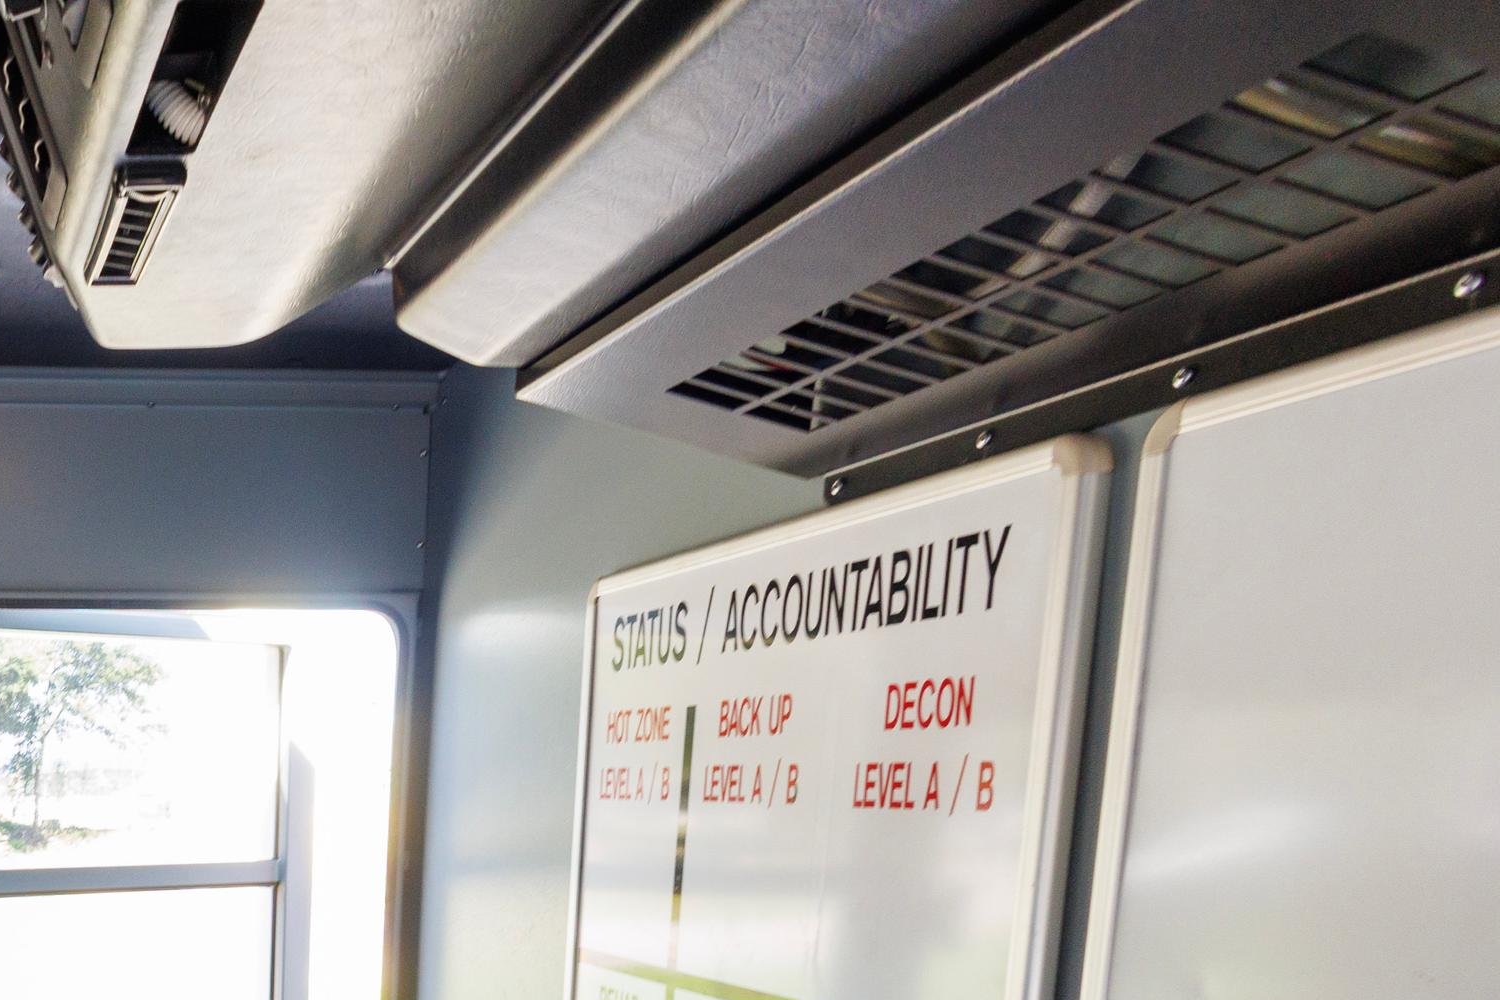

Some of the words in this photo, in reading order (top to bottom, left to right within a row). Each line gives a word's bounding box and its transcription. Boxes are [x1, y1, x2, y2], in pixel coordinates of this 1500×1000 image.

[611, 602, 688, 672] STATUS
[697, 586, 715, 664] /
[722, 524, 1012, 653] ACCOUNTABILITY
[607, 709, 632, 743] HOT
[635, 706, 671, 741] ZONE
[718, 697, 763, 738] BACK
[769, 694, 793, 734] UP
[884, 676, 975, 730] DECON
[600, 767, 633, 800] LEVEL
[636, 767, 644, 799] A
[648, 763, 658, 804] /
[661, 767, 669, 800] B
[703, 764, 745, 802] LEVEL
[749, 765, 763, 802] A
[768, 758, 782, 808] /
[786, 764, 799, 804] B
[853, 761, 915, 809] LEVEL
[923, 762, 940, 810] A
[949, 753, 969, 816] /
[976, 761, 995, 811] B
